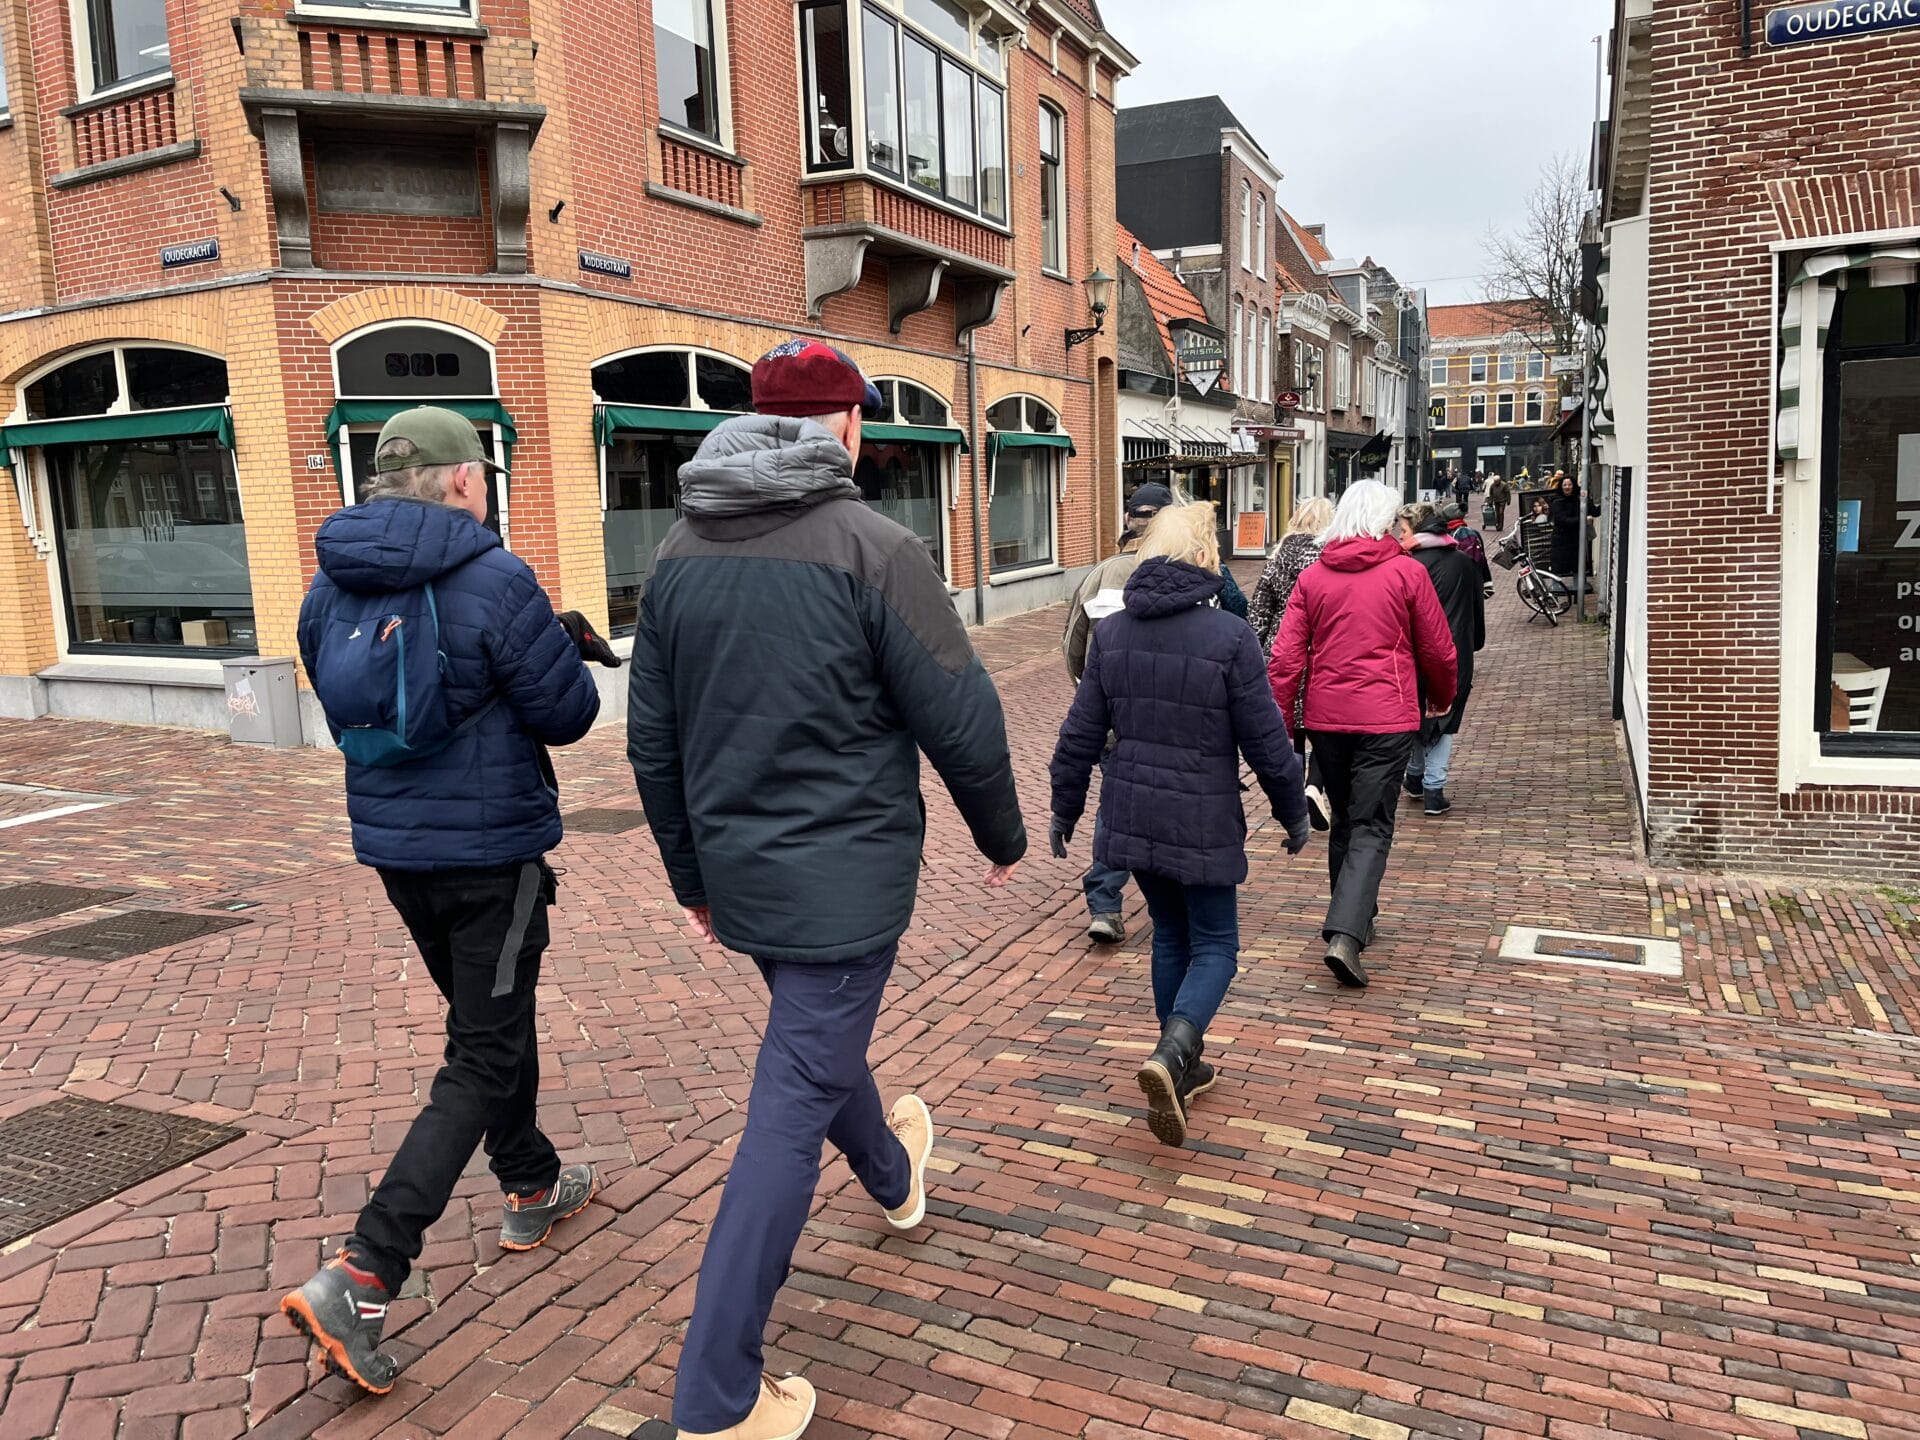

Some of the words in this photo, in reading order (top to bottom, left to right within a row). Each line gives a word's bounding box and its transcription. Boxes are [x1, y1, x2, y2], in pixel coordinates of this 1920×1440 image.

[164, 243, 211, 263] OUDEGRACHT
[584, 255, 629, 275] RIDDERSTRAAT
[308, 456, 323, 469] 164
